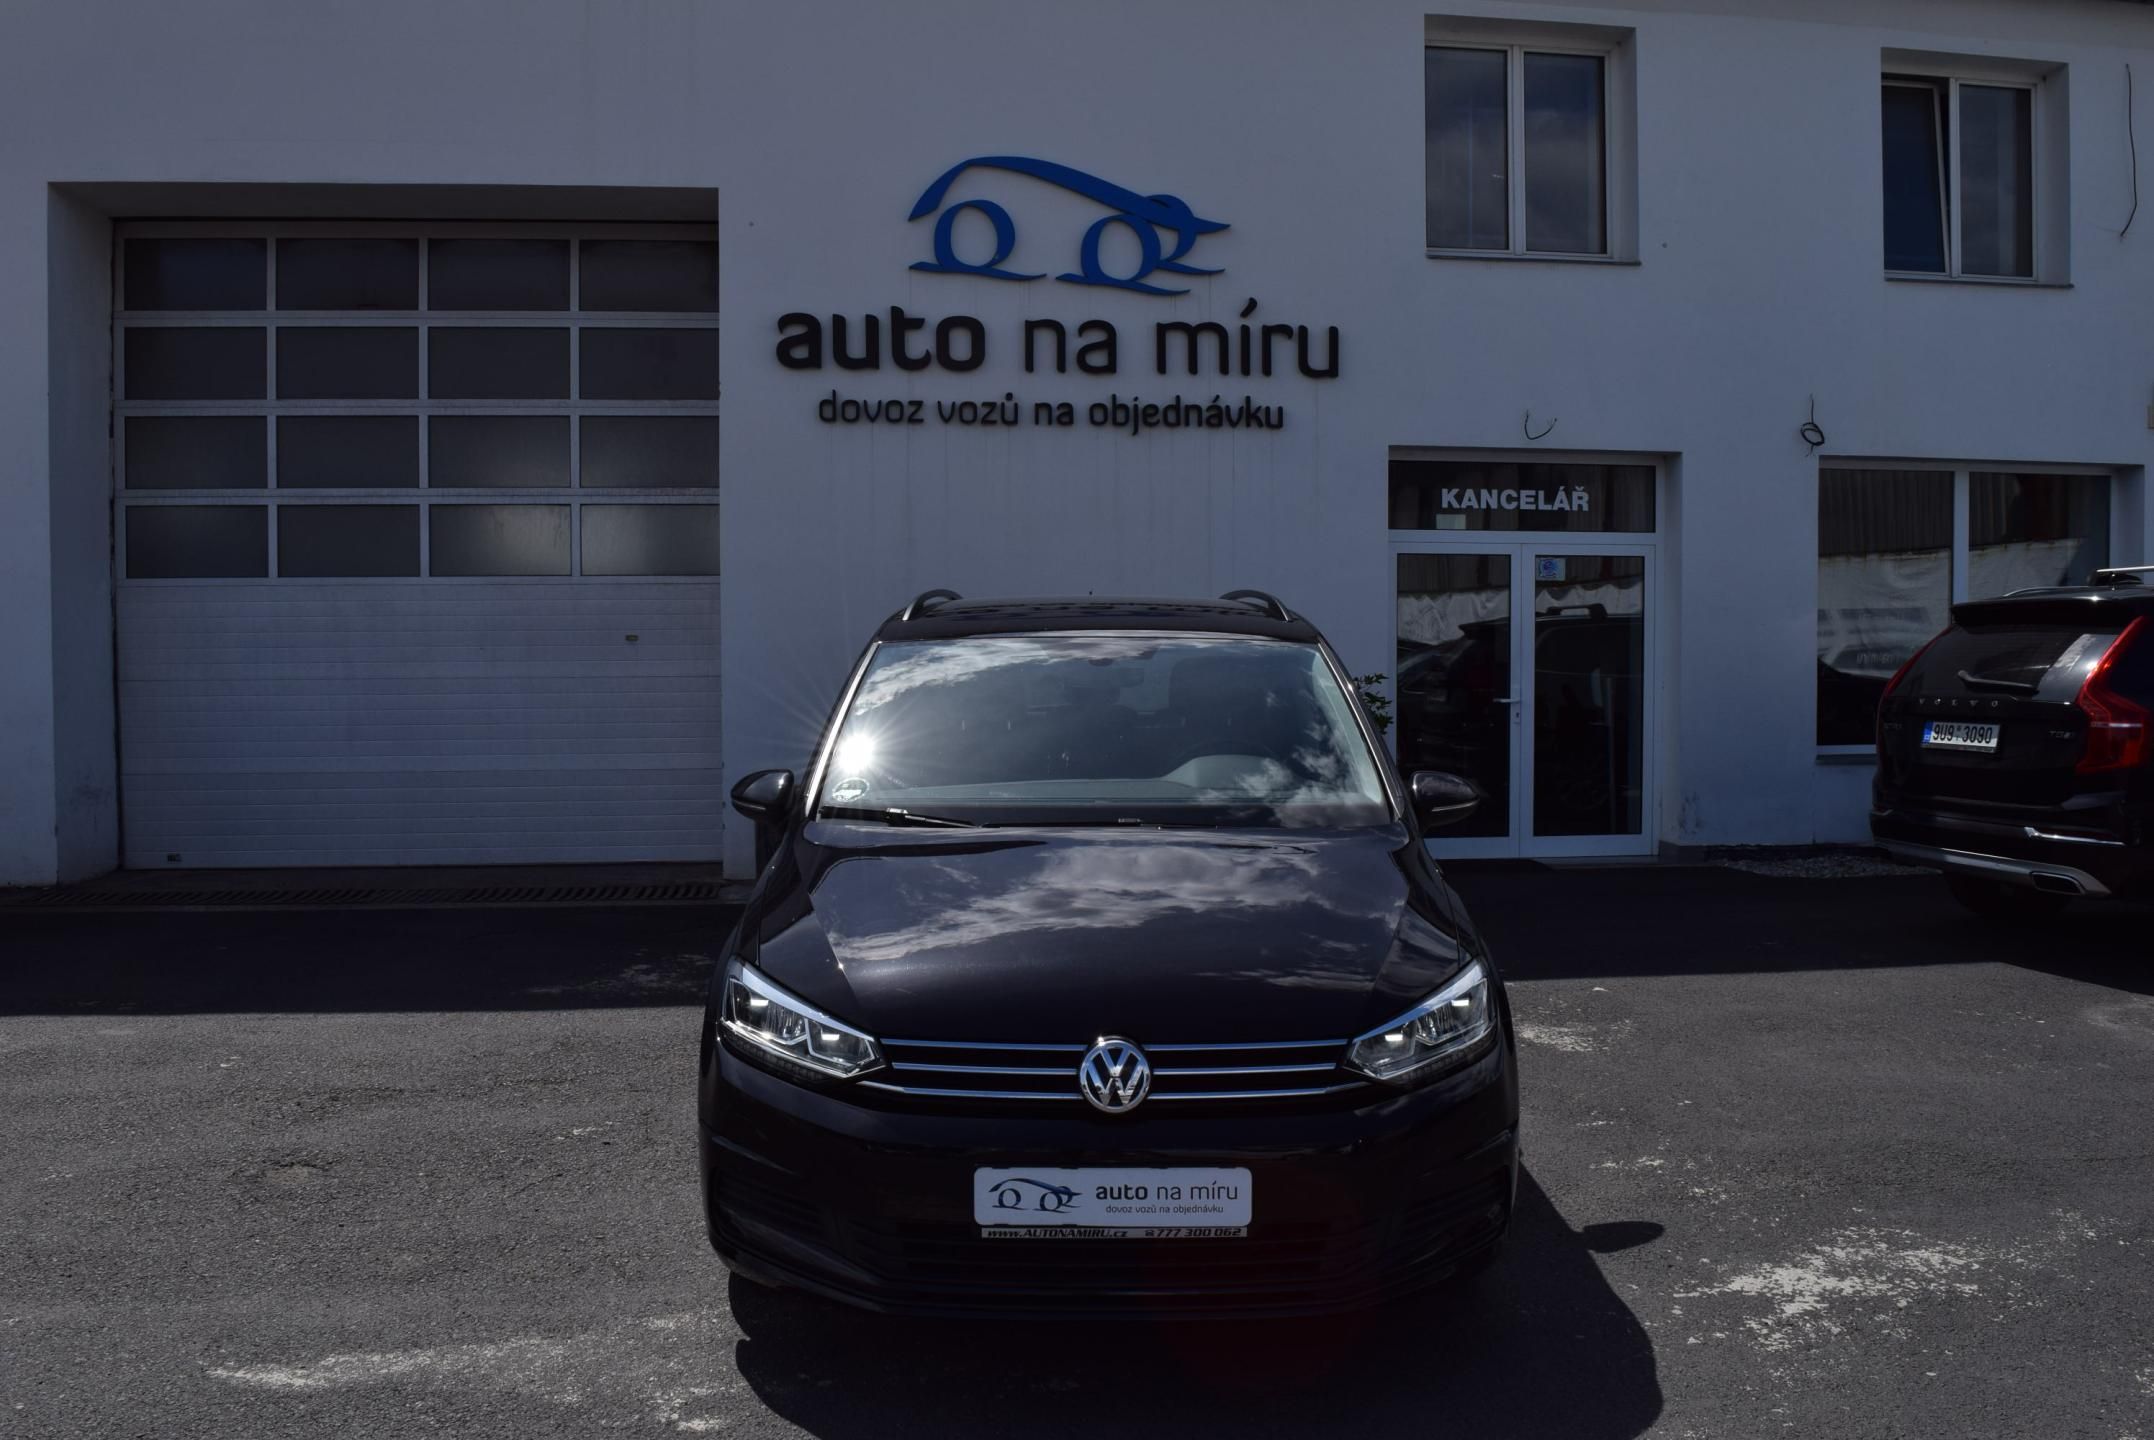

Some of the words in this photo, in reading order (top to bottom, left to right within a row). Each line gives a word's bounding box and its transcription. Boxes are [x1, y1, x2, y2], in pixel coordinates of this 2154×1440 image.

[776, 305, 986, 371] auto
[1024, 318, 1118, 374] na
[1155, 297, 1340, 379] míru
[818, 390, 924, 424] dovoz
[937, 392, 1018, 426] vozů
[1034, 400, 1074, 426] na
[1088, 394, 1284, 436] objednávku
[1441, 486, 1590, 512] KANCELÁŘ
[1932, 723, 1955, 741] 9U9
[1961, 725, 1993, 744] 3090
[1096, 1184, 1148, 1200] auto
[1157, 1186, 1181, 1200] na
[1190, 1180, 1238, 1200] míru
[1105, 1204, 1132, 1214] dovoz
[1135, 1204, 1157, 1214] vozů
[1159, 1206, 1171, 1214] na
[1172, 1204, 1224, 1216] objednávku
[1156, 1228, 1180, 1238] 777
[1183, 1228, 1212, 1238] 300
[1214, 1227, 1242, 1237] 062
